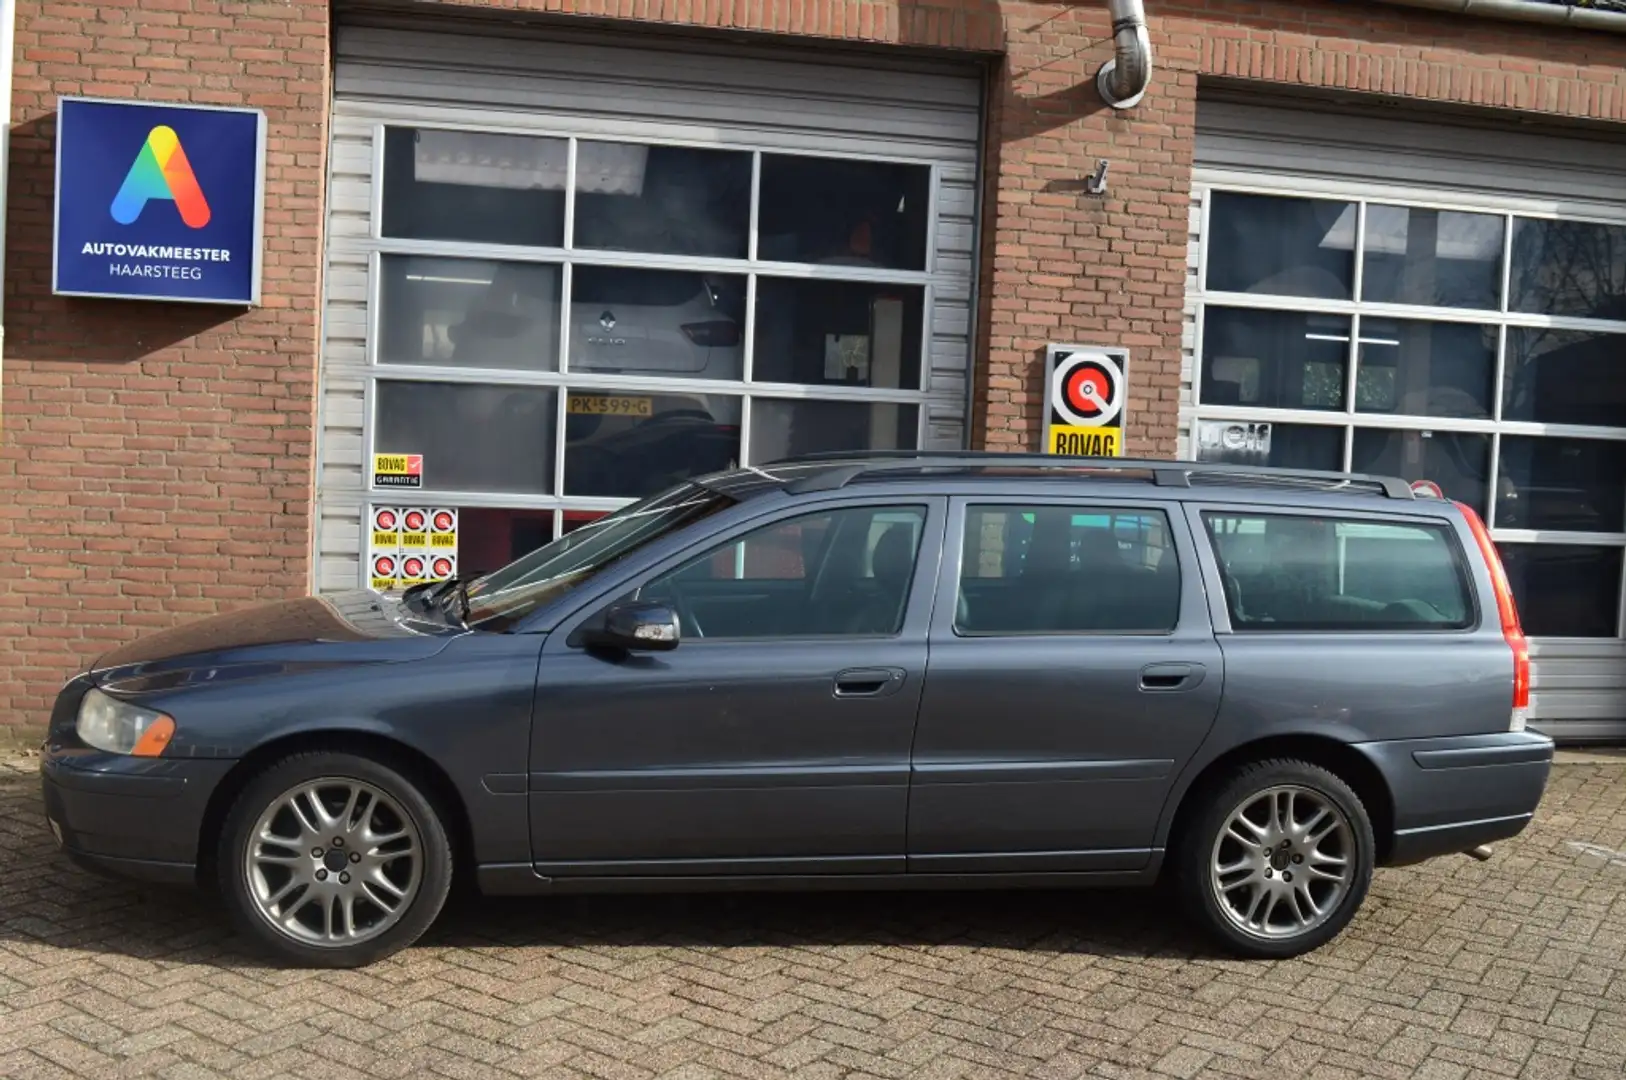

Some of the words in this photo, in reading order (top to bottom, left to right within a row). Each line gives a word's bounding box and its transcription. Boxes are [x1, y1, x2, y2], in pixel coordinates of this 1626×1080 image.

[81, 242, 230, 262] AUTOVAKMEESTER
[109, 263, 202, 280] HAARSTEEG
[1056, 432, 1114, 456] BOVAG
[377, 457, 405, 471] BOVAG
